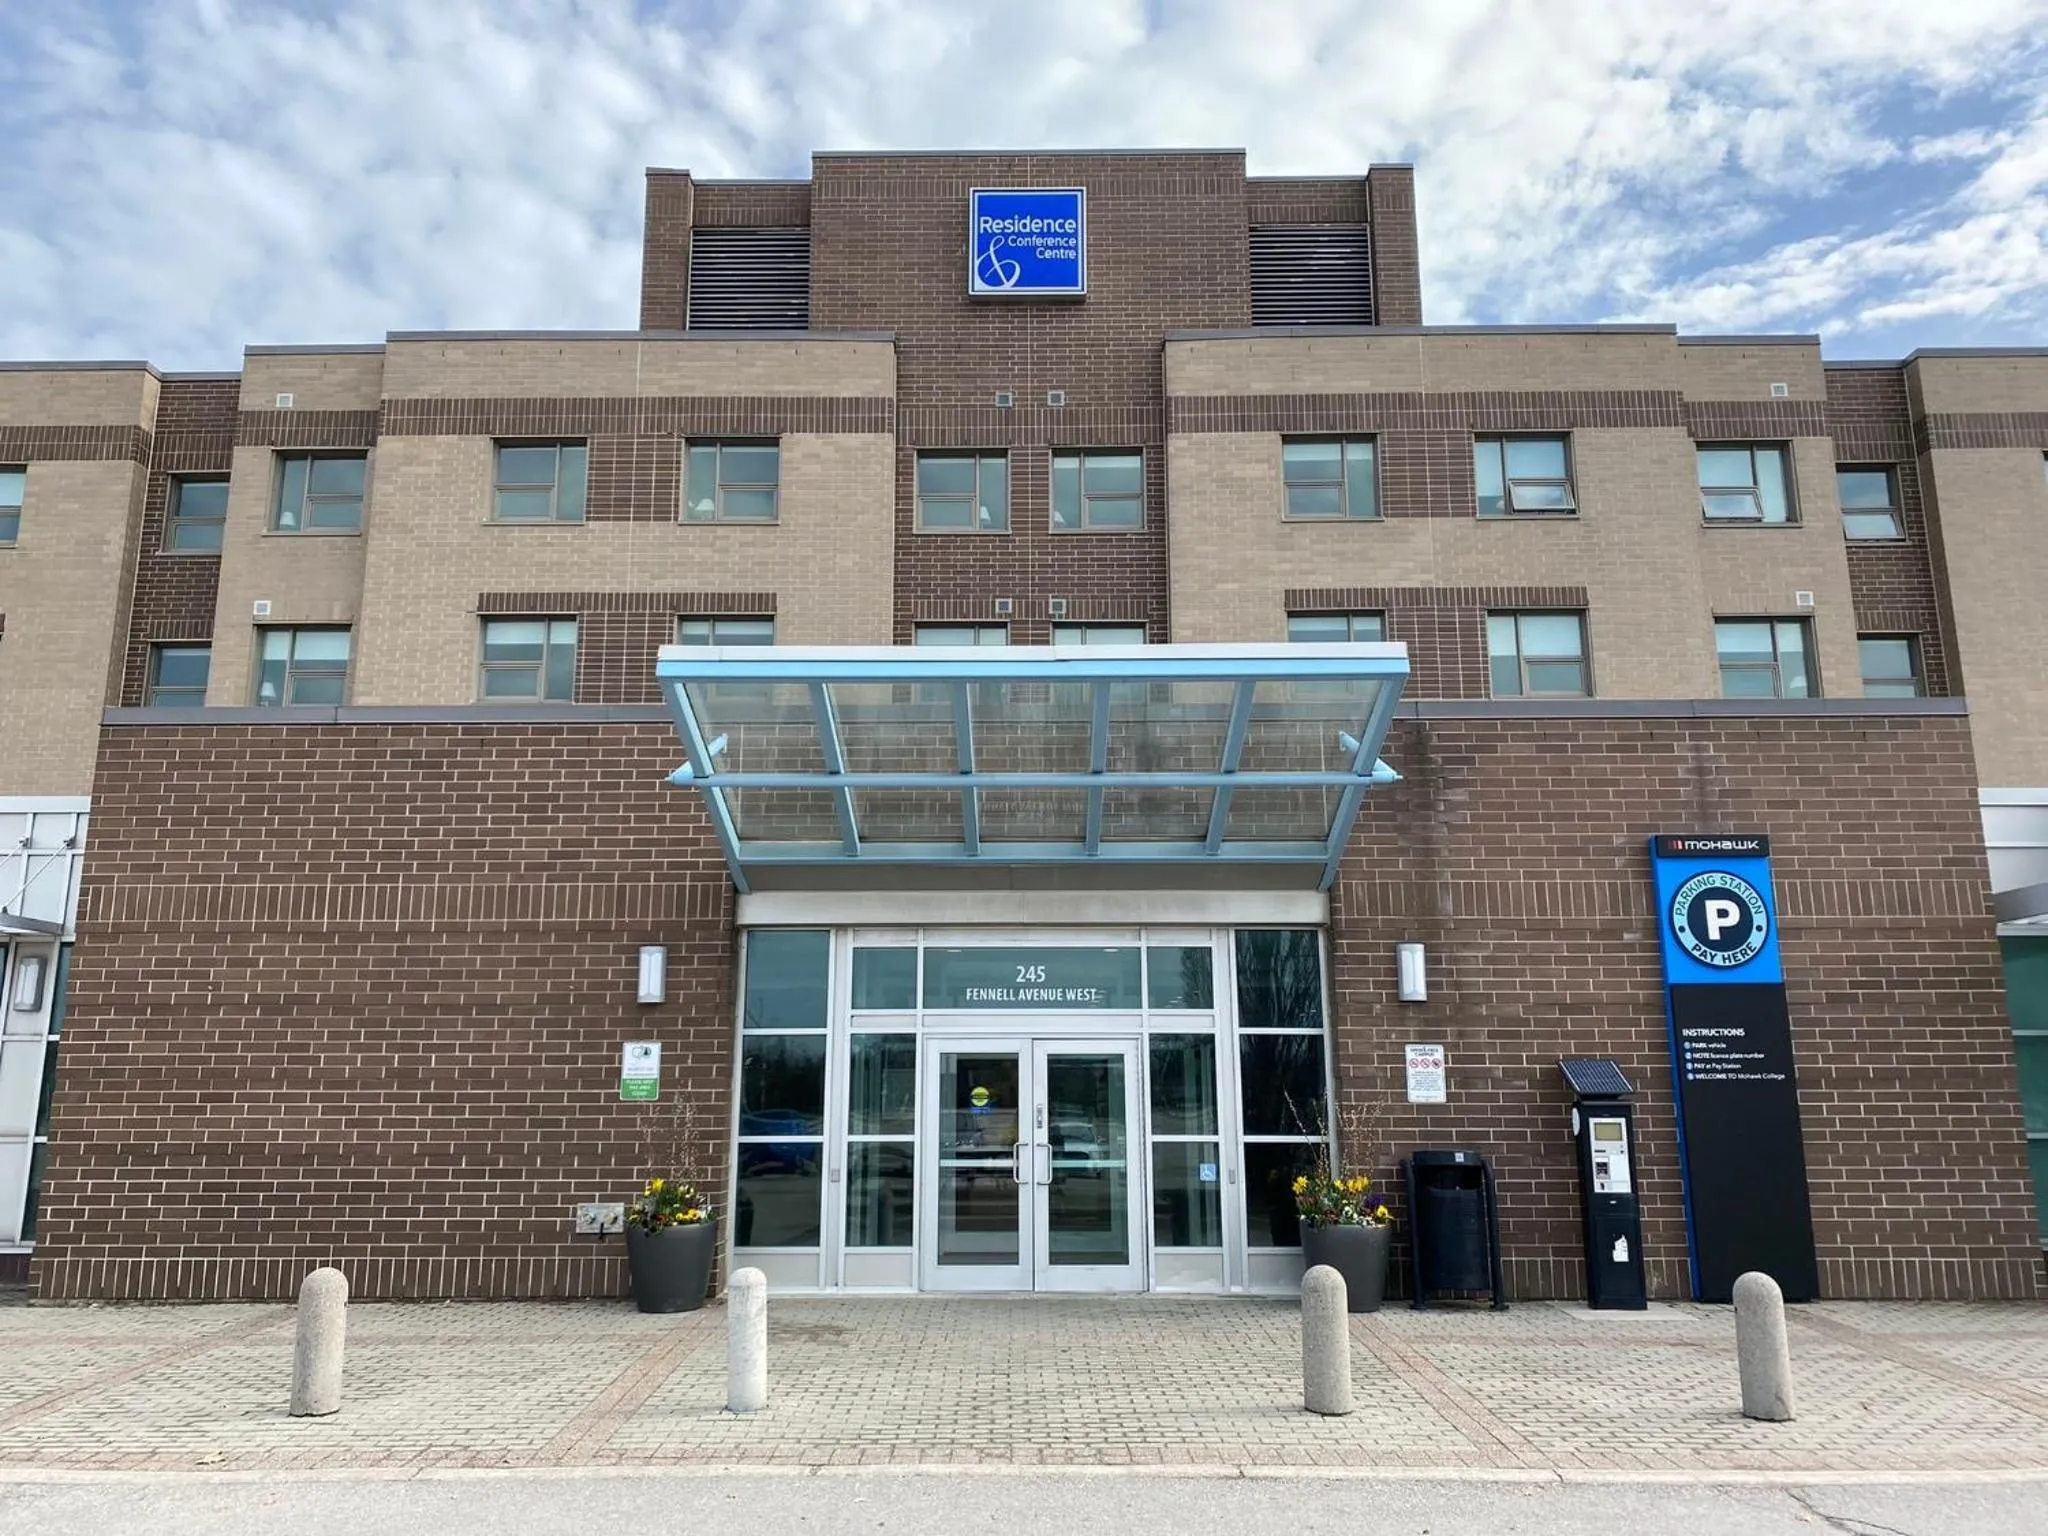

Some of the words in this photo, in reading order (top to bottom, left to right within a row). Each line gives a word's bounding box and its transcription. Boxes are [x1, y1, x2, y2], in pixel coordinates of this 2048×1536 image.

[980, 215, 1076, 233] Residence
[976, 235, 1020, 288] &
[1008, 235, 1076, 247] Conference
[1036, 247, 1076, 259] Centre
[1675, 875, 1716, 917] PARKING
[1720, 876, 1763, 915] STATION
[1704, 899, 1741, 941] P
[1691, 943, 1718, 964] PAY
[1722, 941, 1758, 964] HERE
[1016, 965, 1046, 983] 245
[966, 988, 1015, 1001] FENNELL
[1018, 988, 1064, 1001] AVENUE
[1065, 988, 1097, 1001] WEST
[1682, 1028, 1746, 1037] INSTRUCTIONS
